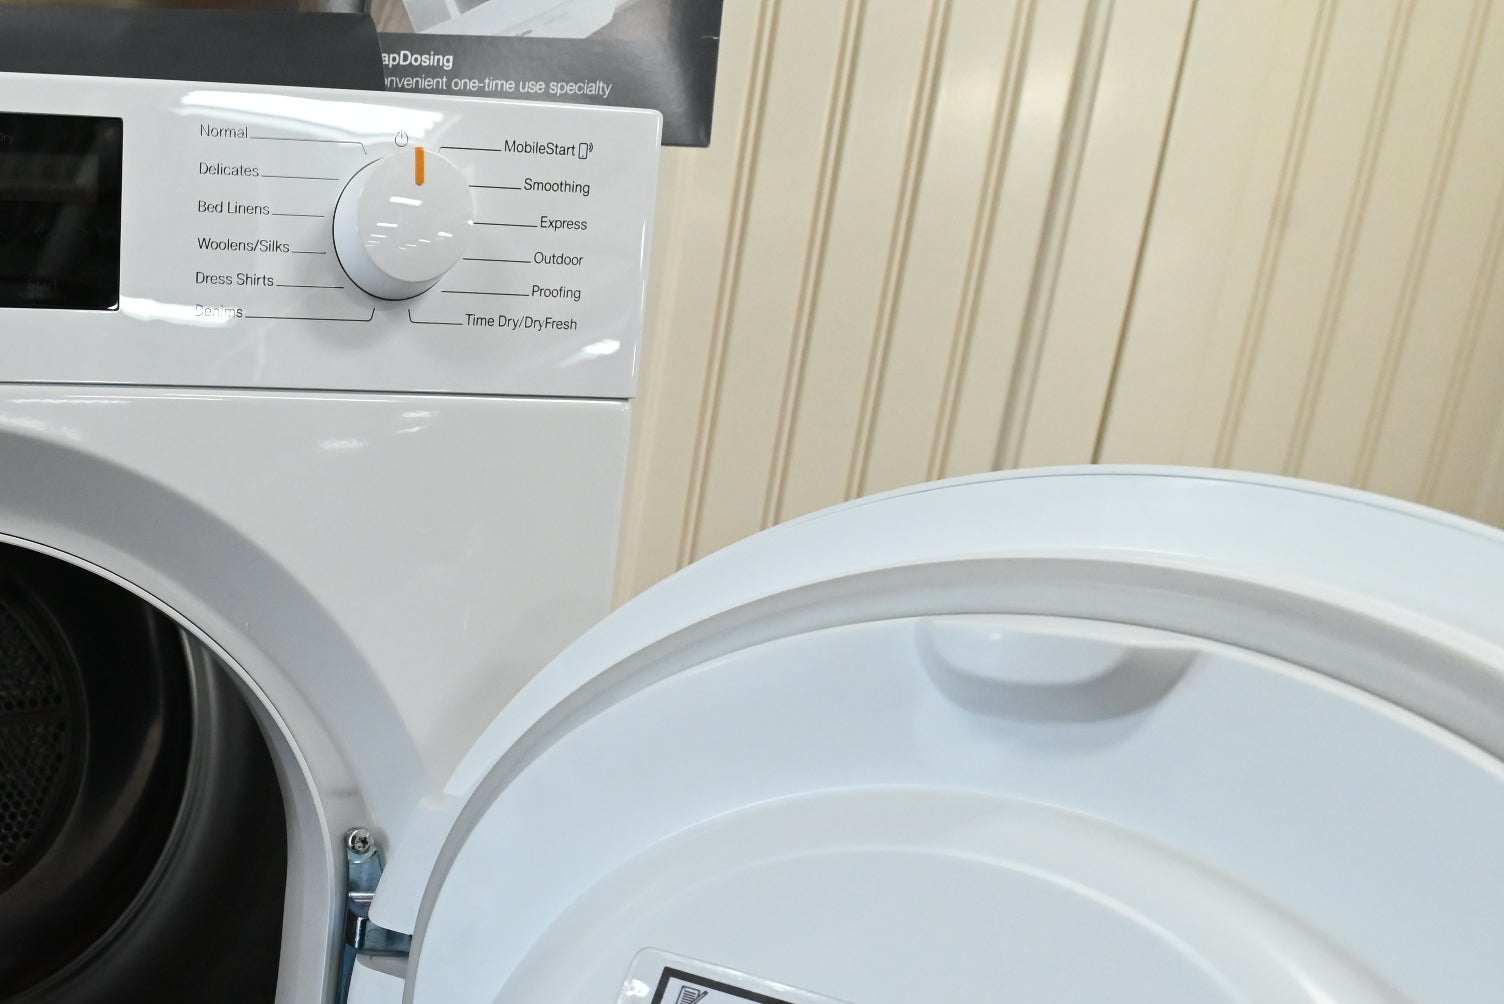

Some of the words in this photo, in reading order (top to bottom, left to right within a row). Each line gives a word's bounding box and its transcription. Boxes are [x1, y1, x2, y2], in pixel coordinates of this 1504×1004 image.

[381, 50, 453, 71] apDosing
[451, 76, 515, 95] one-time
[519, 82, 546, 95] use
[549, 80, 612, 98] specialty
[199, 123, 248, 139] Normal
[504, 140, 576, 157] MobileStart
[198, 162, 260, 177] Delicates
[523, 179, 591, 197] Smoothing
[198, 200, 224, 215] Bed
[227, 201, 270, 216] Linens
[540, 216, 588, 232] Express
[197, 237, 290, 254] Woolens/Silks
[533, 253, 584, 266] Outdoor
[195, 271, 232, 286] Dress
[235, 272, 274, 287] Shirts
[531, 285, 582, 301] Proofing
[465, 313, 495, 329] Time
[498, 315, 578, 332] Dry/DryFresh
